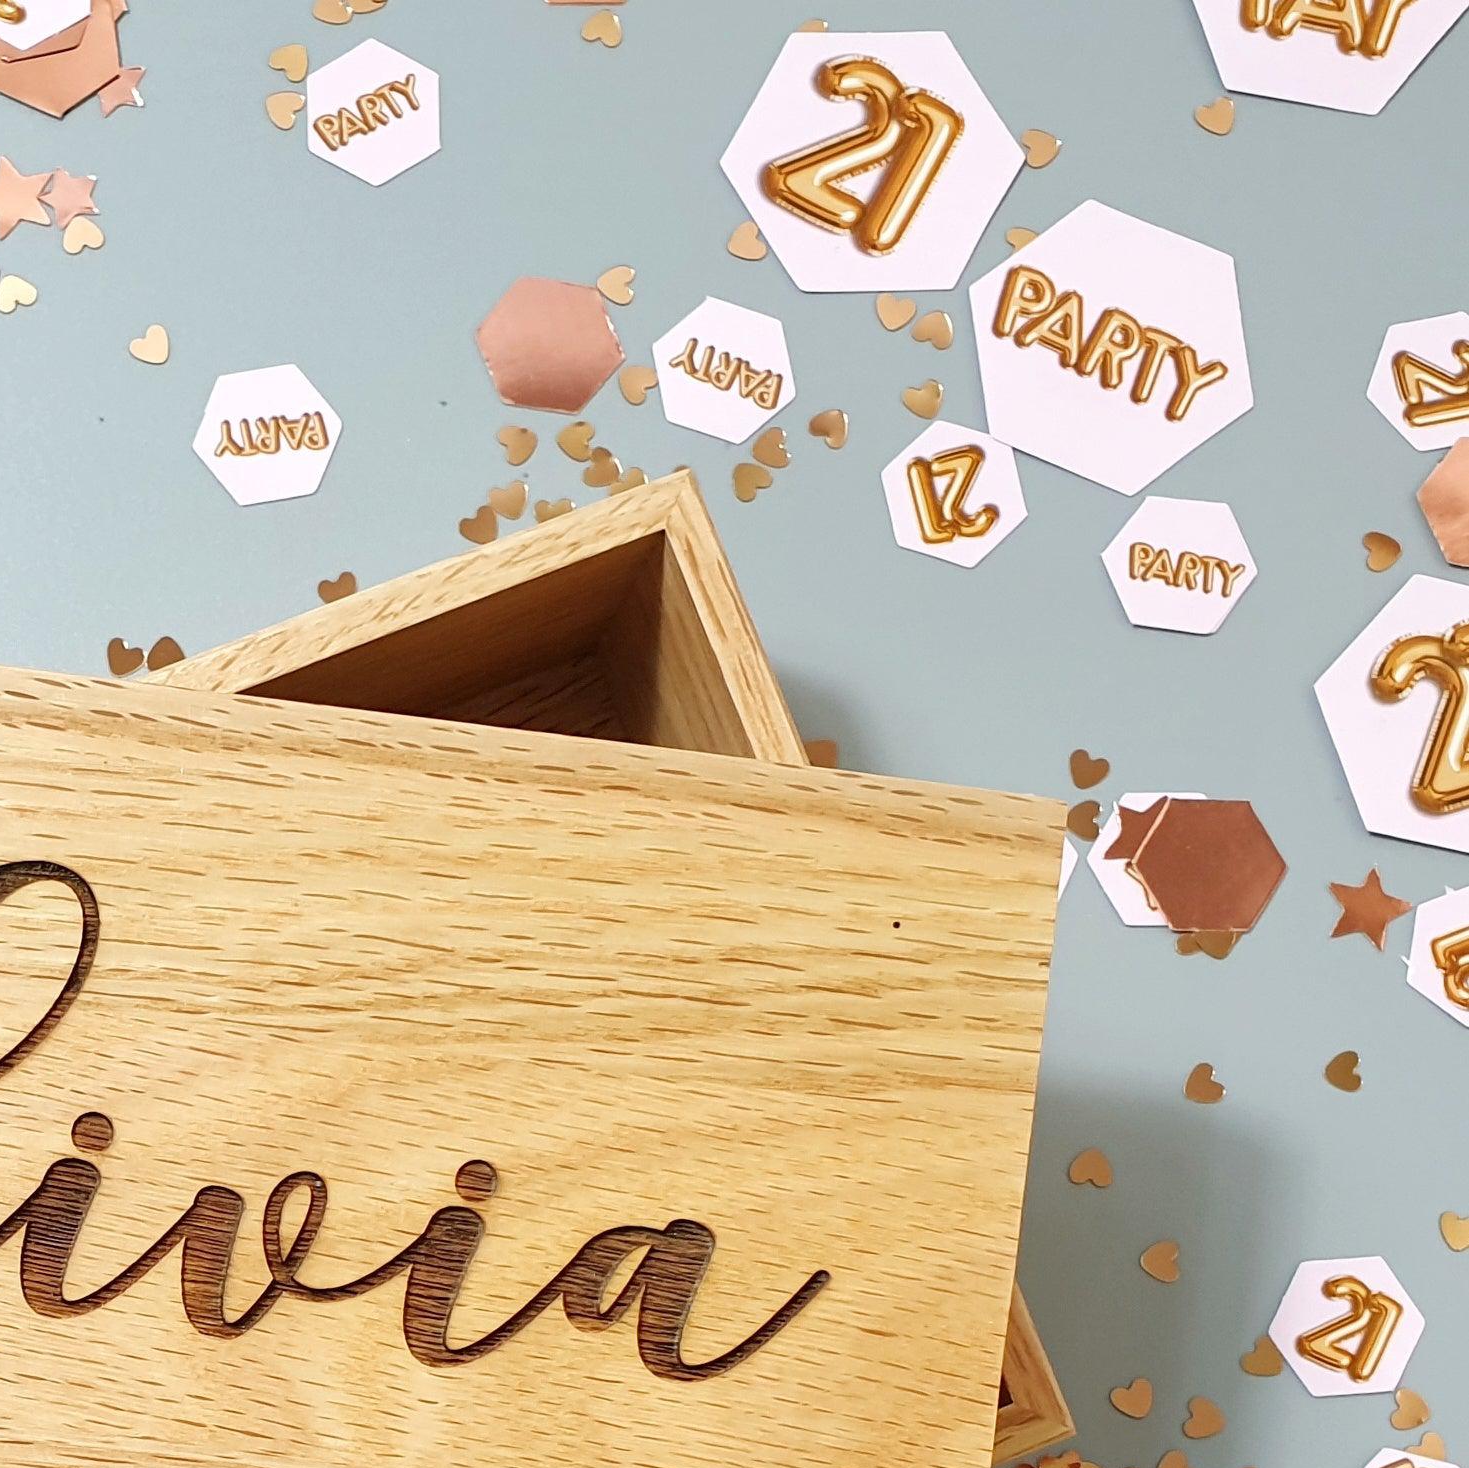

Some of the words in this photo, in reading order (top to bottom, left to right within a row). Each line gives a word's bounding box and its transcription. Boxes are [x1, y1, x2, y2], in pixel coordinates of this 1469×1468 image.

[312, 73, 422, 152] PARTY
[759, 53, 965, 256] 21
[669, 338, 784, 410] PARTY
[991, 264, 1229, 422] PARTY
[214, 410, 331, 457] PARTY
[908, 444, 1000, 545] 21
[1128, 541, 1246, 598] PARTY
[1368, 618, 1469, 816] 2
[1295, 1274, 1404, 1382] 21
